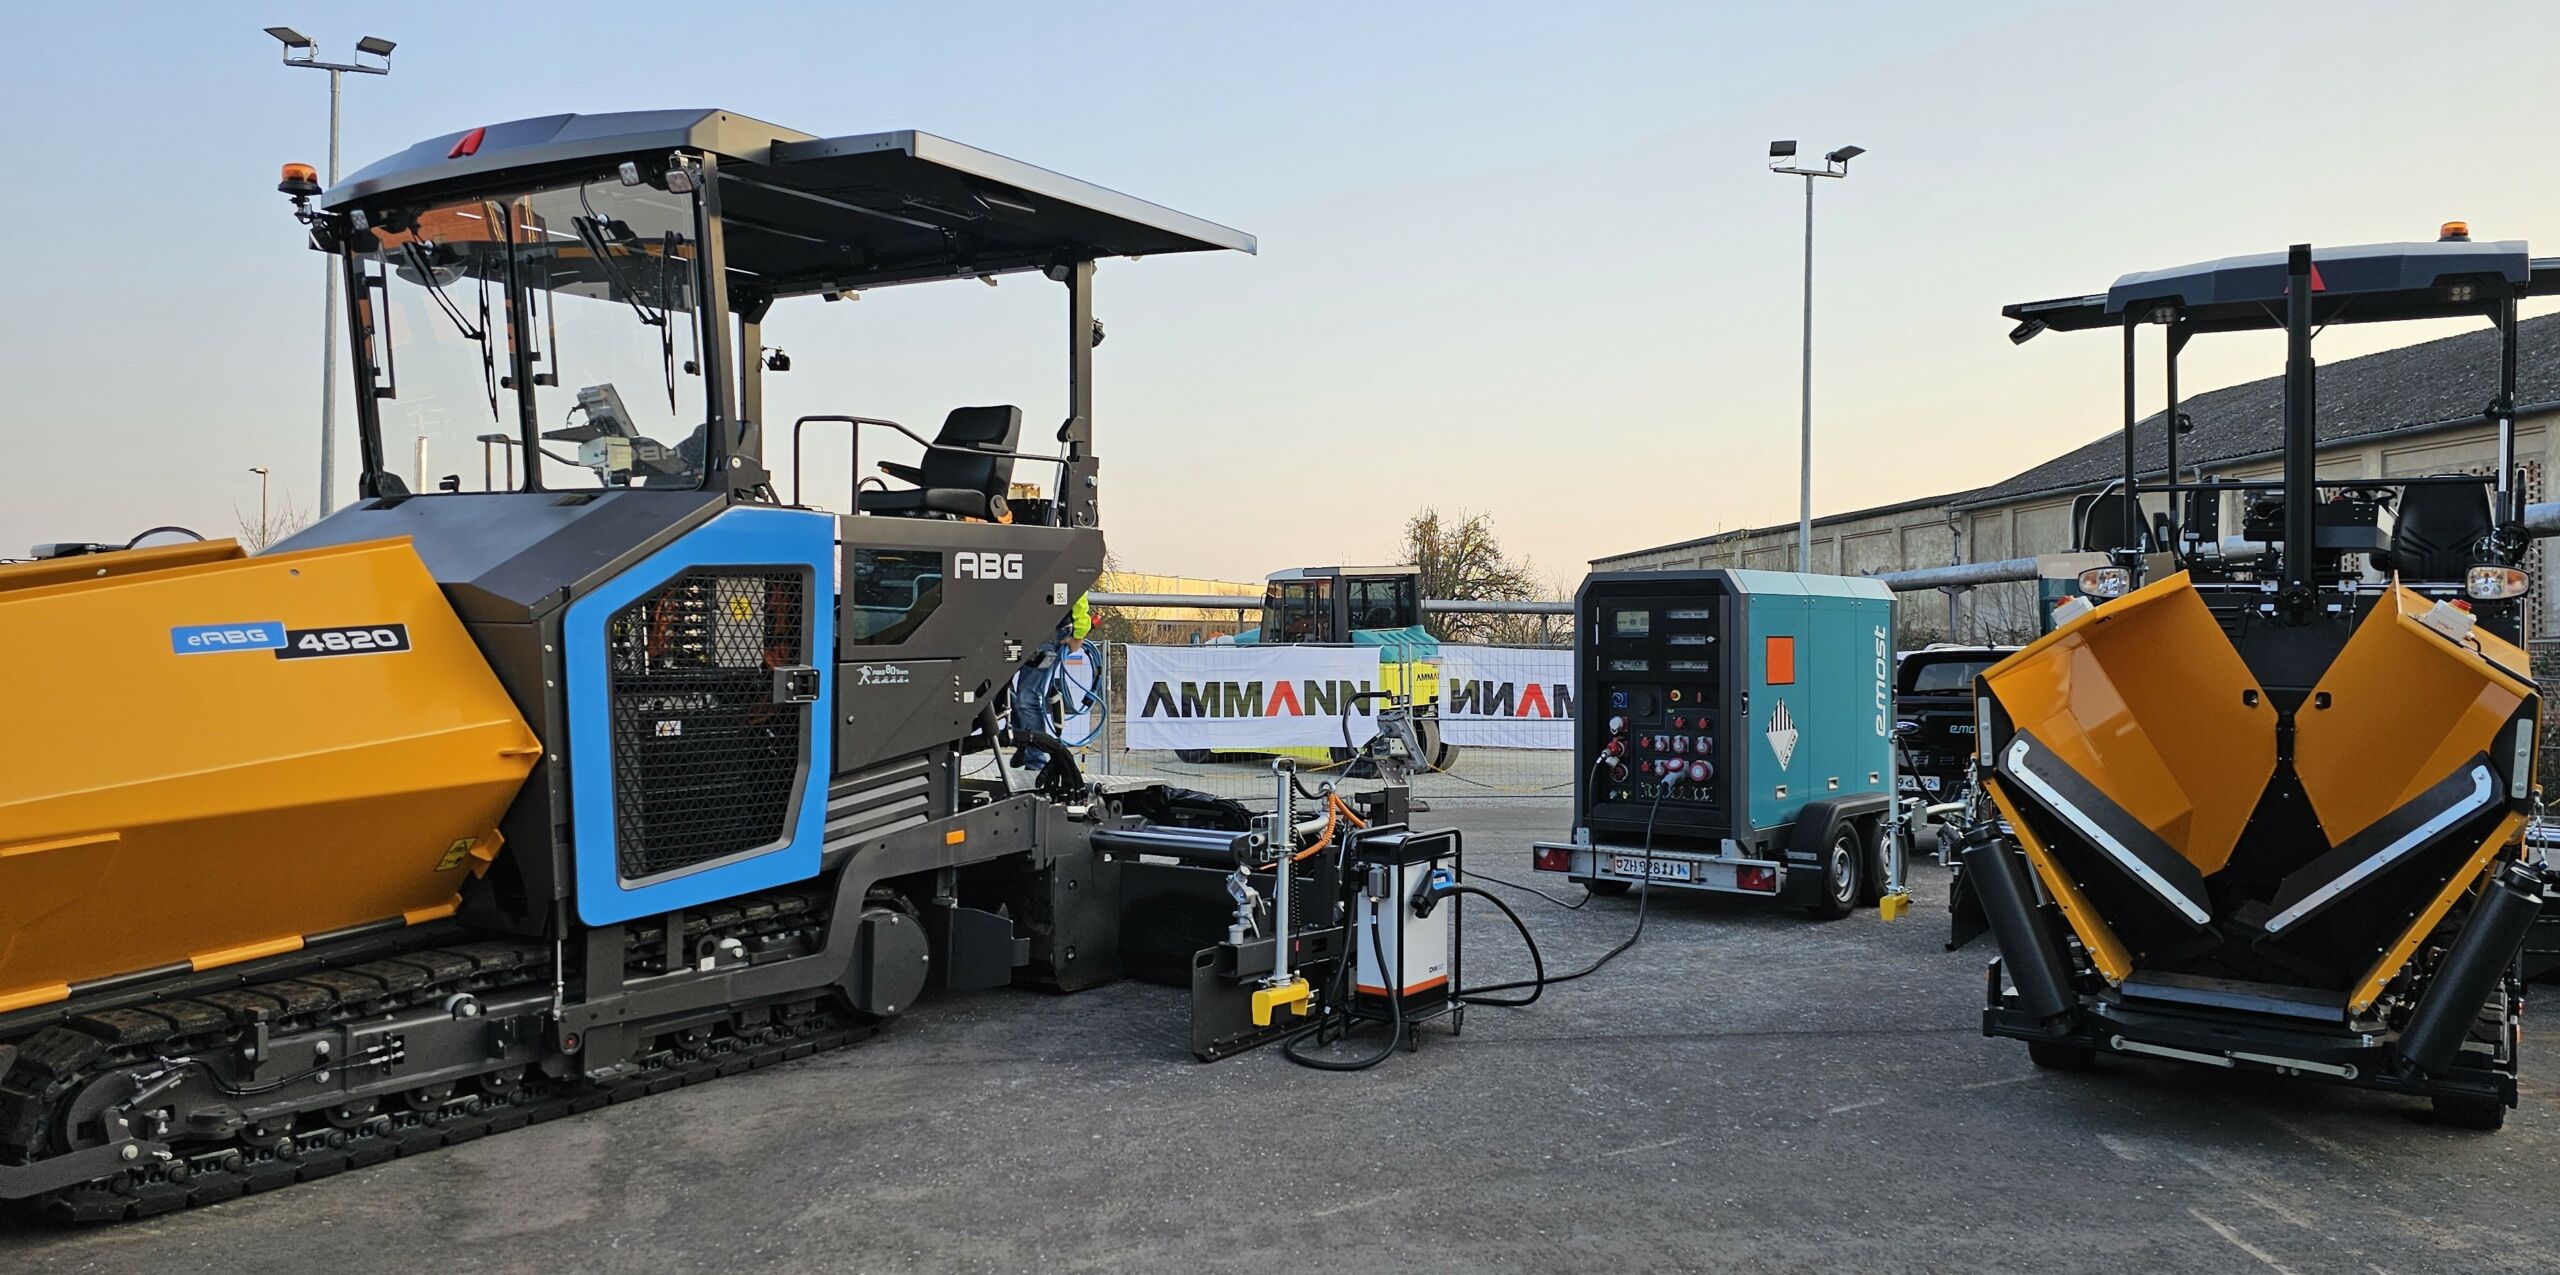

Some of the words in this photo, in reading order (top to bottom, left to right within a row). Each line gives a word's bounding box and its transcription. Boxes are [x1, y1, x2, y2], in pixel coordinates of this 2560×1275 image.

[954, 551, 1023, 580] ABG
[187, 628, 269, 646] eABG
[297, 629, 399, 652] 4820
[885, 664, 896, 675] 80
[1874, 624, 1886, 737] emost
[1140, 680, 1371, 718] AMMANN
[1623, 858, 1637, 873] ZH
